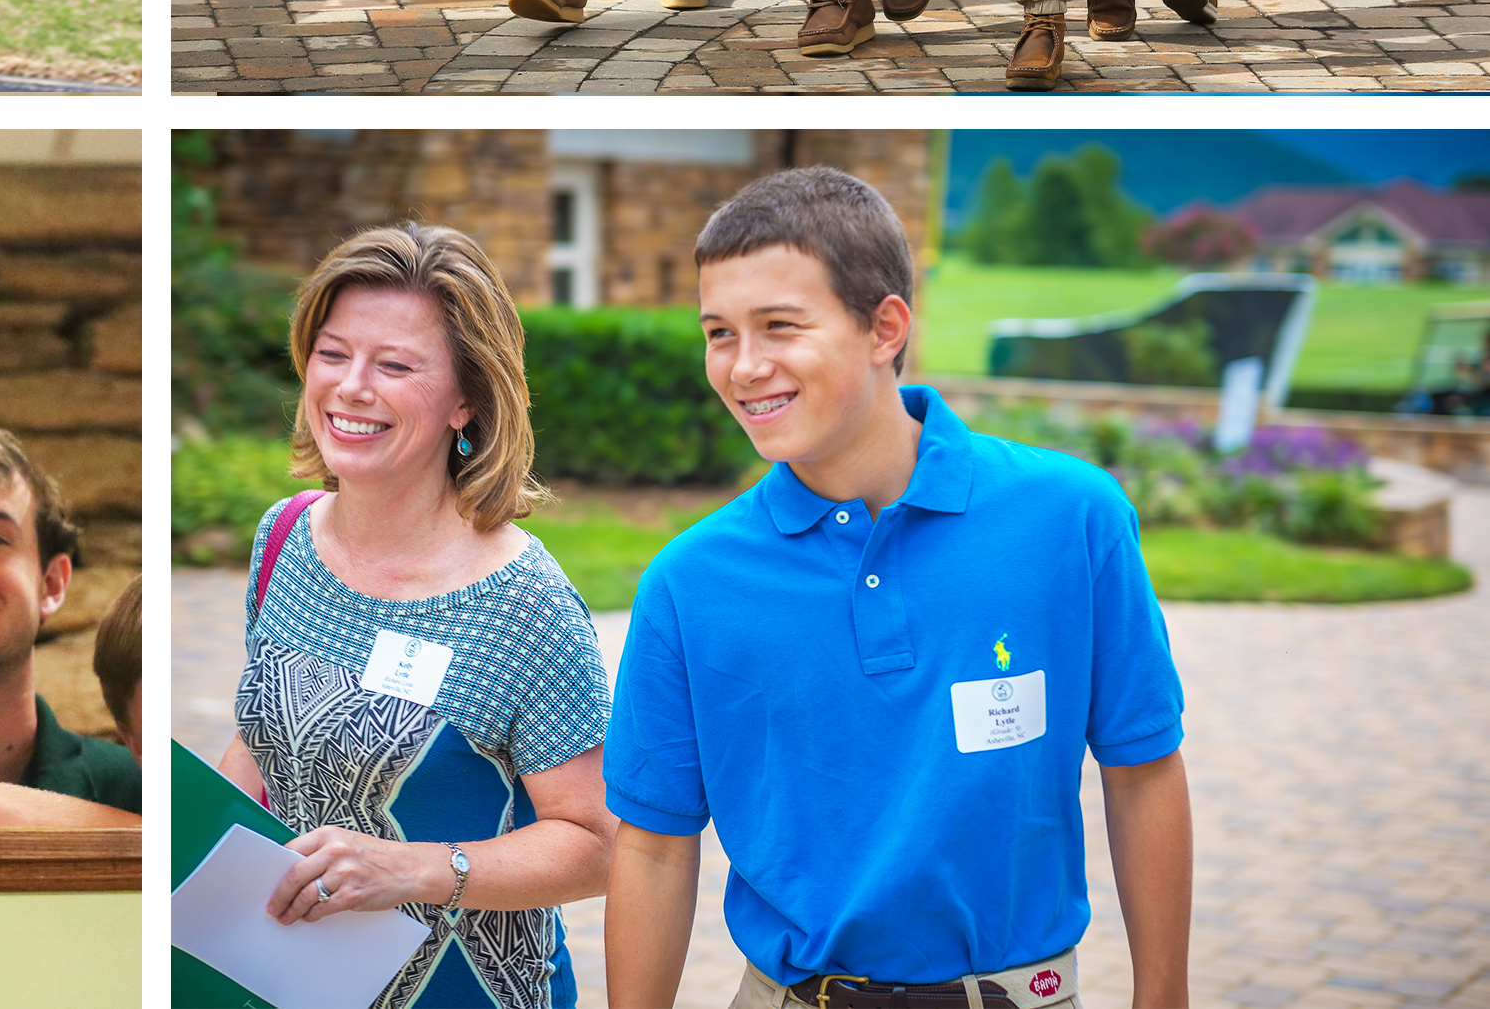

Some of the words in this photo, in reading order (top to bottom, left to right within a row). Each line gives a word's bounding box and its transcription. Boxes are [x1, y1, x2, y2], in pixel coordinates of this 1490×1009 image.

[988, 705, 1020, 717] Richard
[995, 717, 1016, 728] Lytle
[1033, 976, 1059, 992] BAMA
